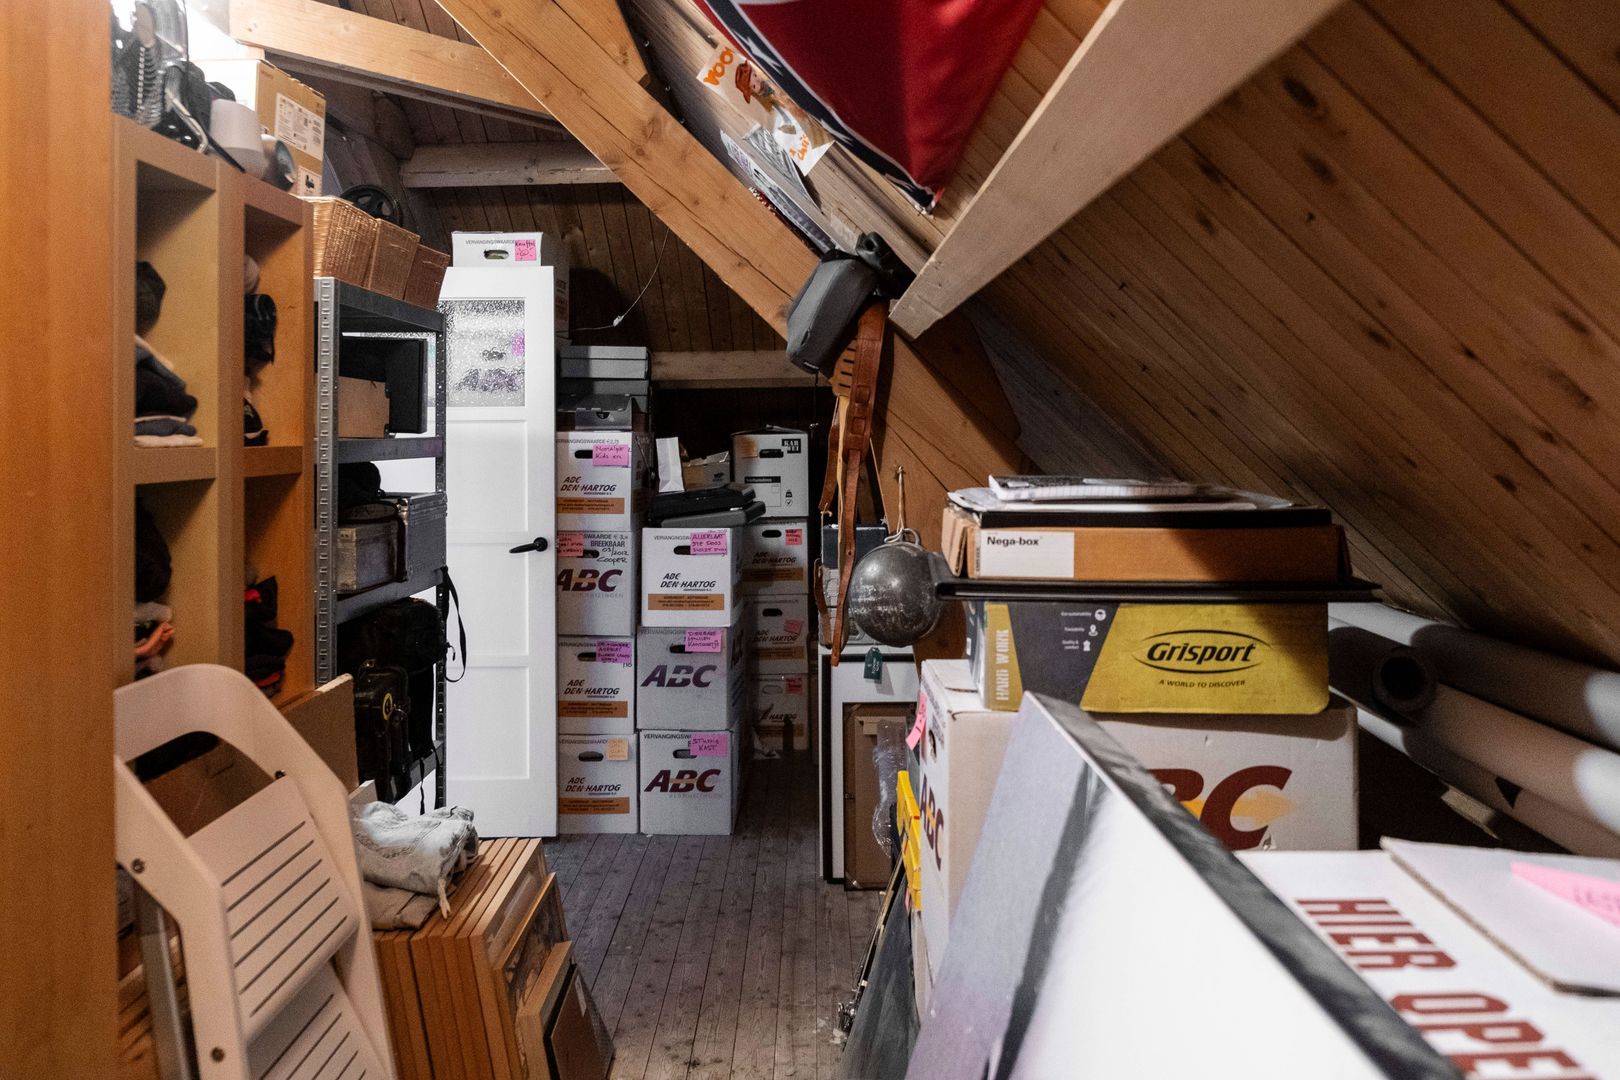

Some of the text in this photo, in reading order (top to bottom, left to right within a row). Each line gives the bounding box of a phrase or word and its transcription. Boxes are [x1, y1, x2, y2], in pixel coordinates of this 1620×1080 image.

[580, 484, 617, 492] HARTOG
[986, 535, 1039, 547] Nega-box
[557, 569, 623, 592] ABC
[680, 580, 716, 588] HARTOG
[995, 629, 1010, 701] HARD WORK
[1147, 642, 1256, 665] Grisport
[641, 664, 717, 688] ABC
[1208, 680, 1245, 688] DISCOVER
[564, 687, 620, 695] DEN HARTOG
[565, 784, 622, 792] DEN HARTOG
[644, 768, 721, 793] ABC
[920, 773, 944, 871] ABC
[1296, 899, 1456, 970] HIER
[1390, 991, 1599, 1080] OPE
